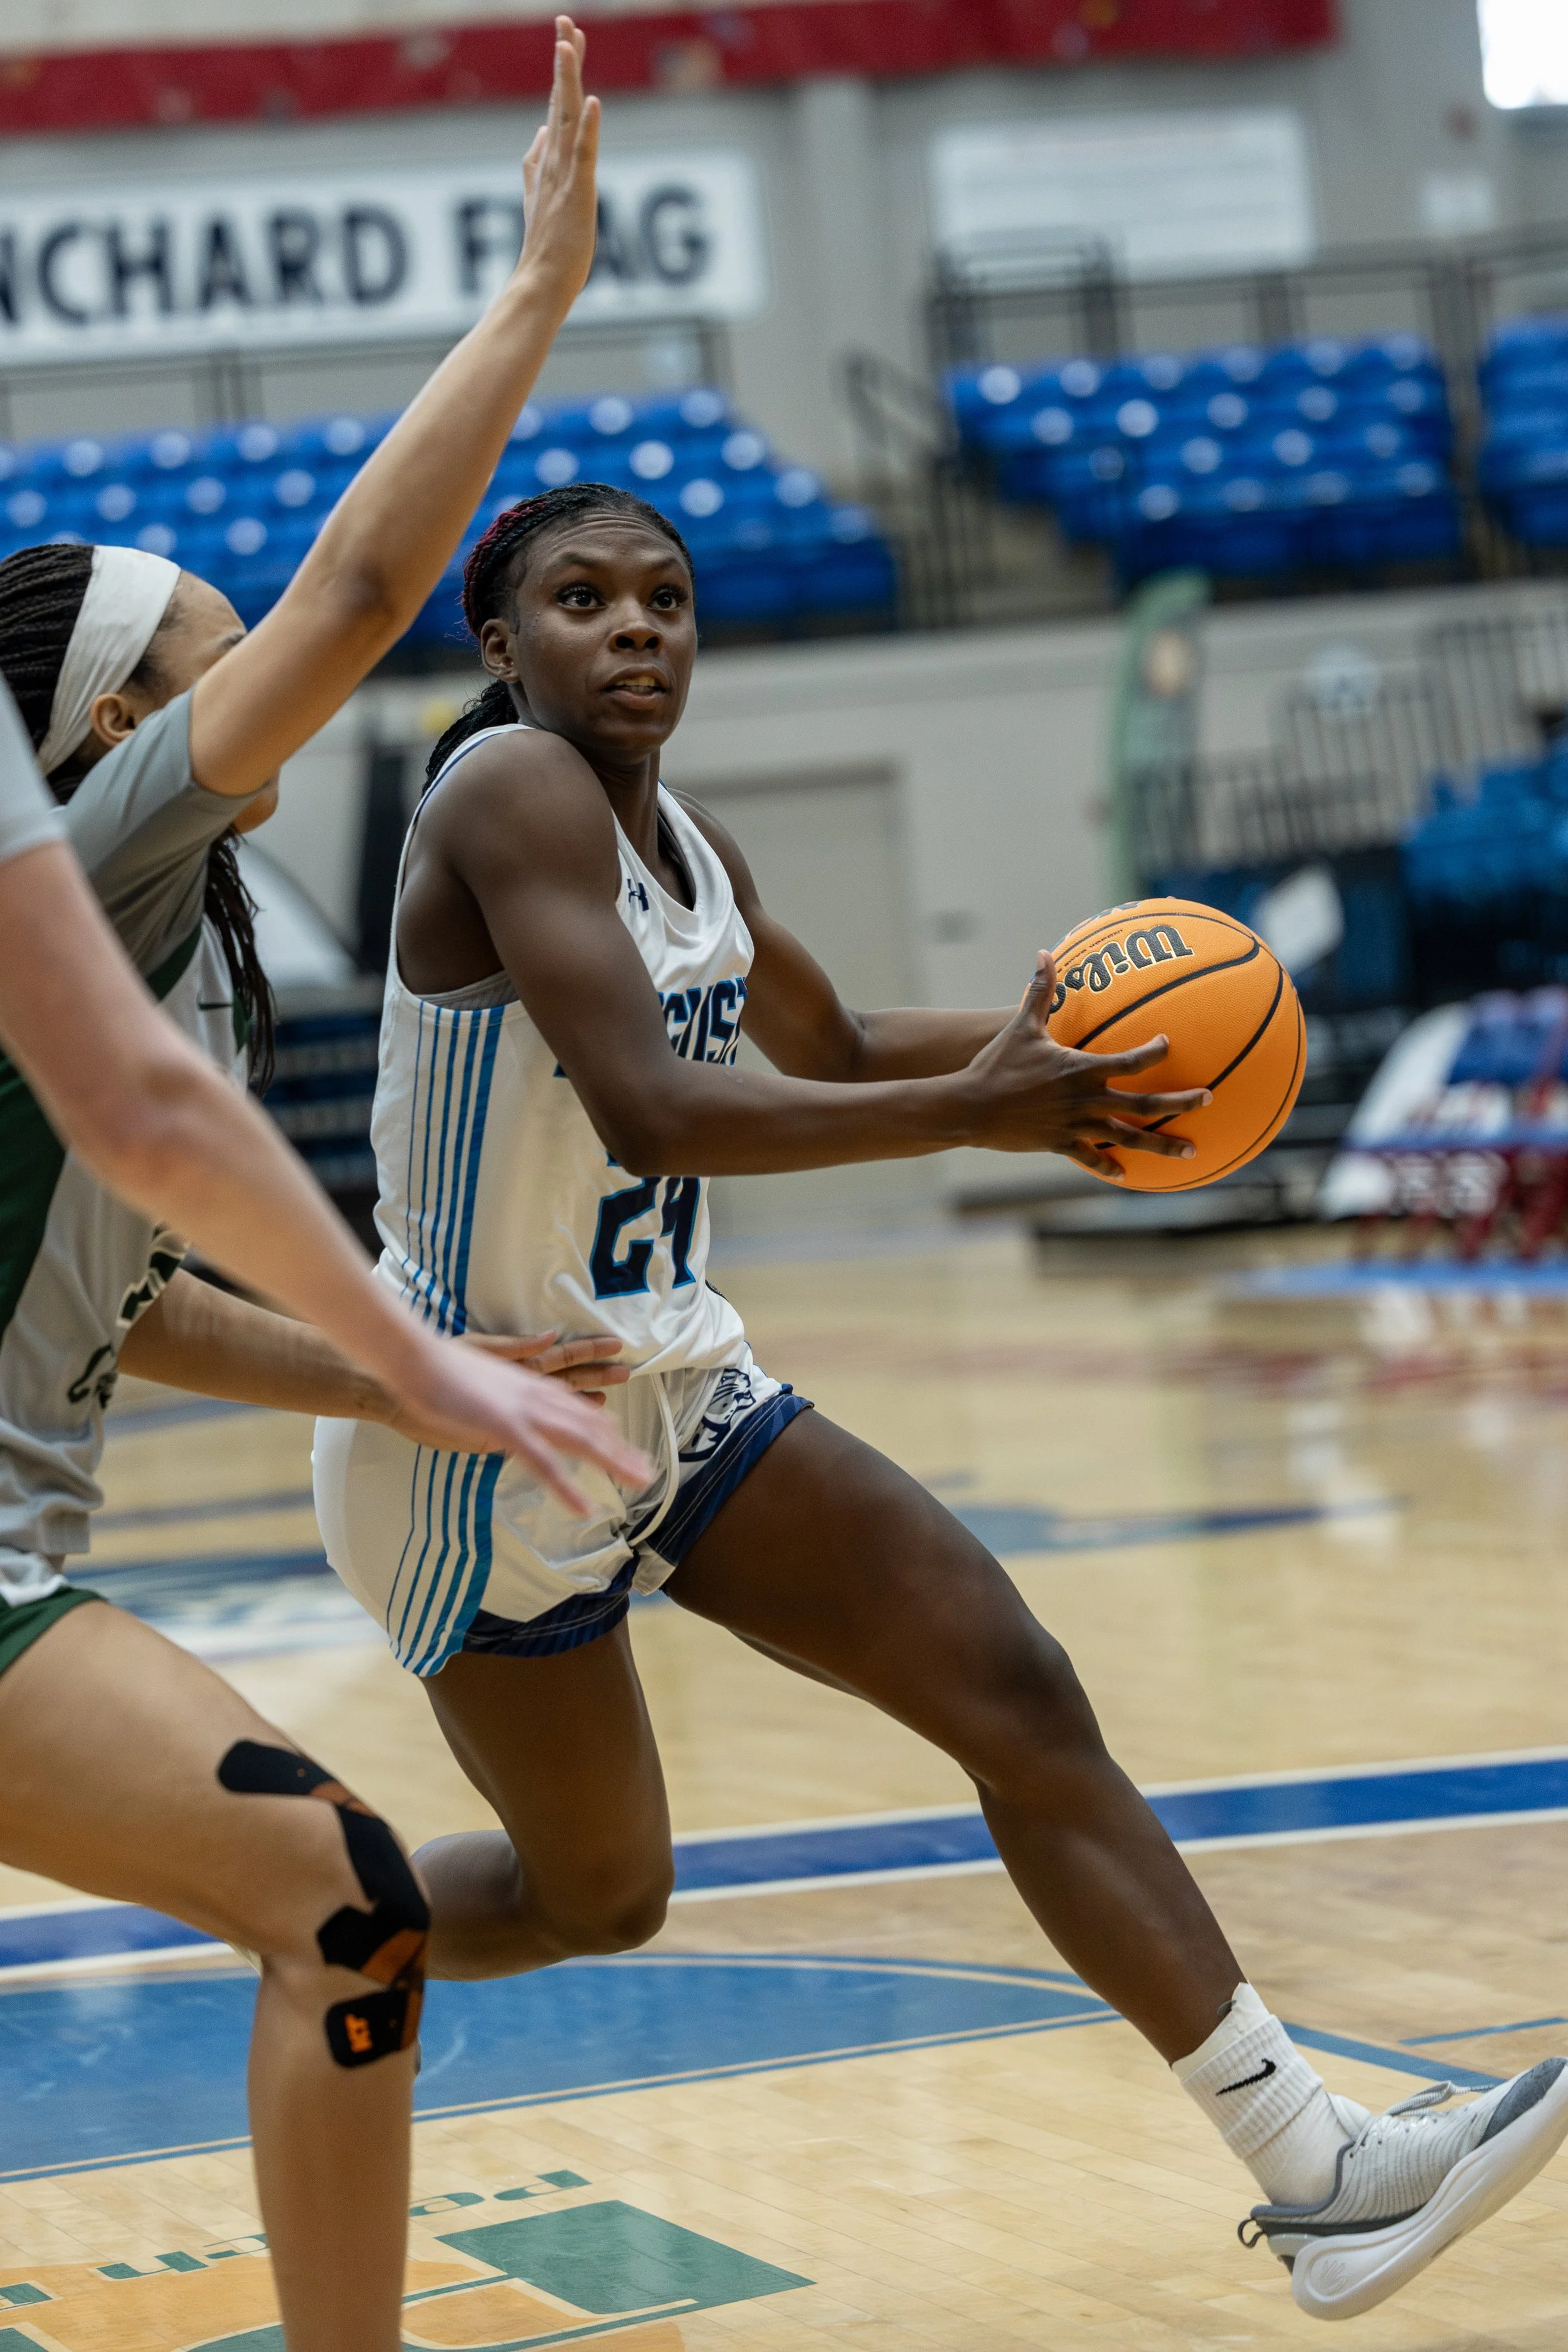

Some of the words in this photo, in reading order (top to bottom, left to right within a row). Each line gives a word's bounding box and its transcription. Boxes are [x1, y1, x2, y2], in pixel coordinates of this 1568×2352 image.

[0, 204, 411, 327] CHARD
[455, 185, 712, 298] FAG
[590, 1150, 701, 1300] 24
[95, 2169, 593, 2280] Pech
